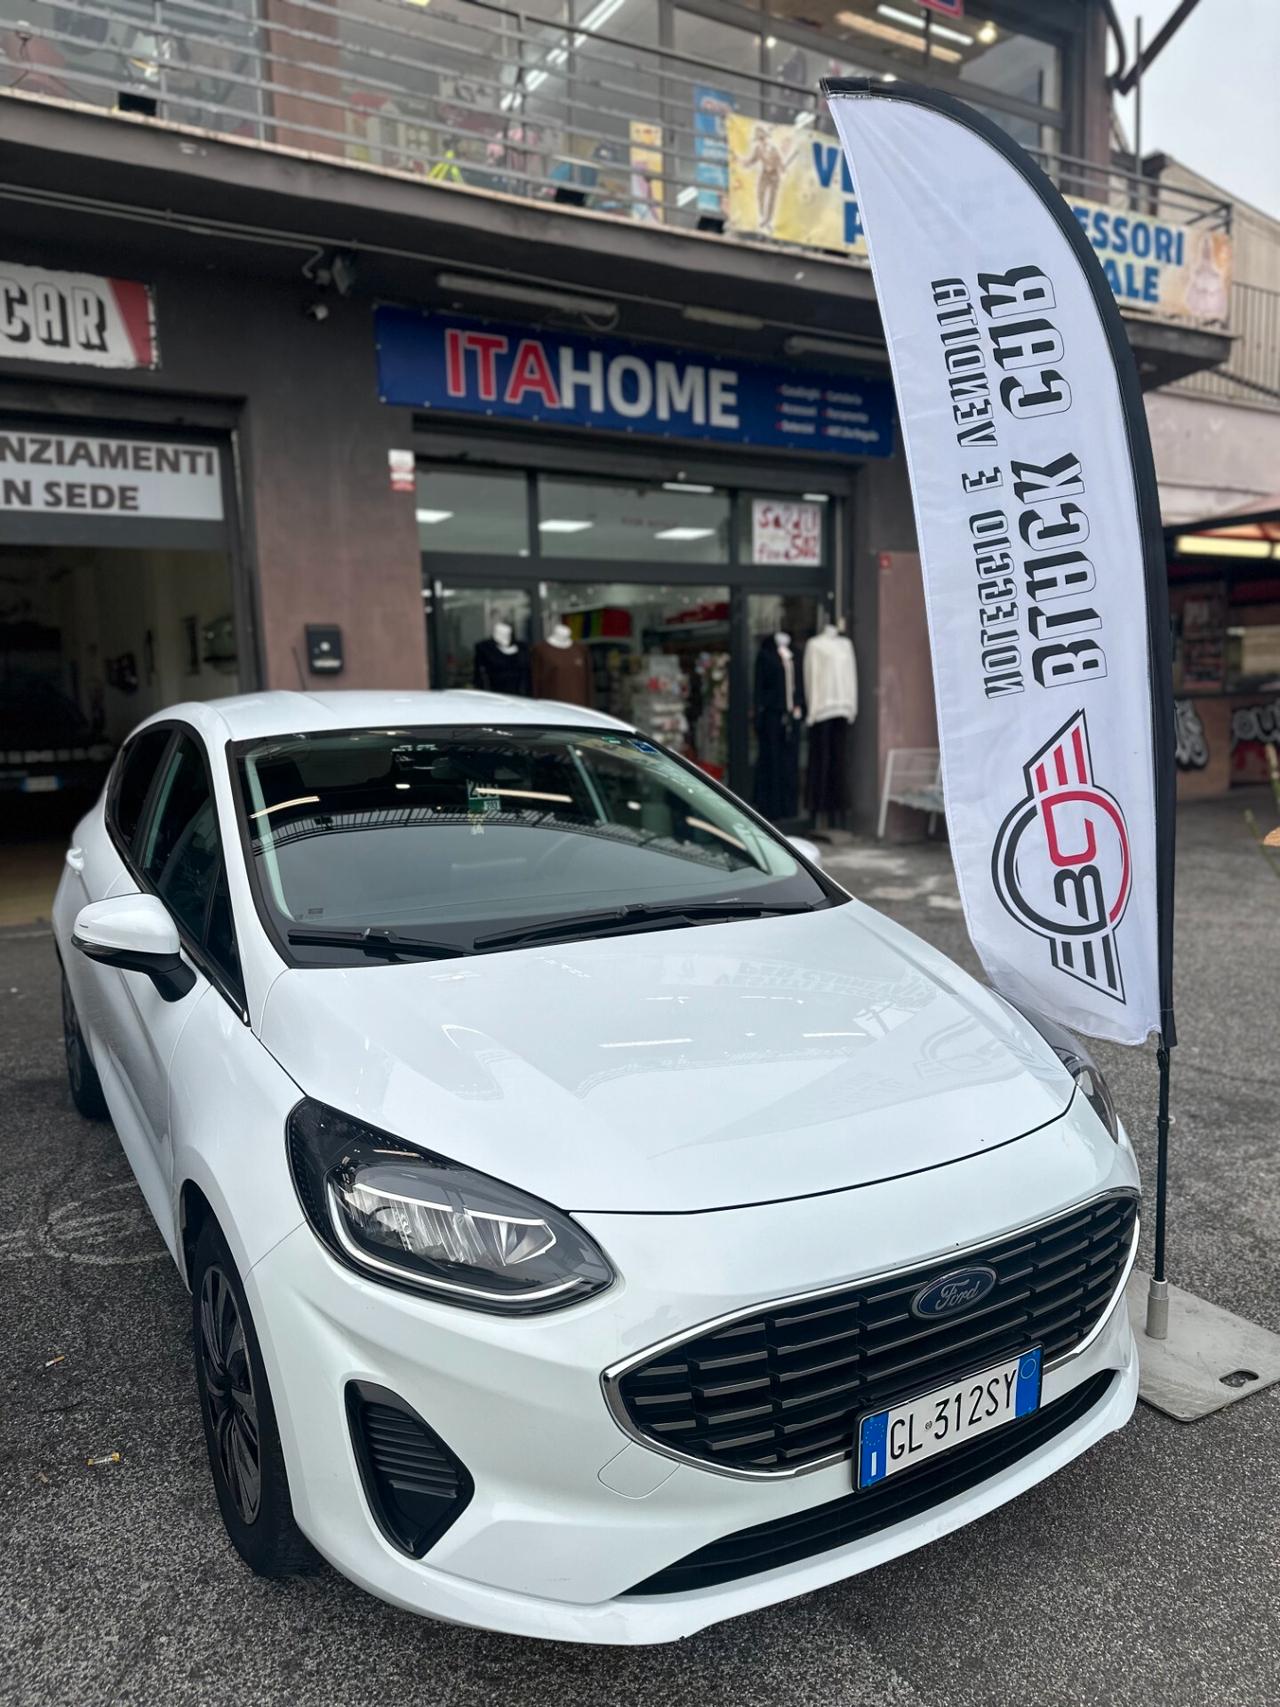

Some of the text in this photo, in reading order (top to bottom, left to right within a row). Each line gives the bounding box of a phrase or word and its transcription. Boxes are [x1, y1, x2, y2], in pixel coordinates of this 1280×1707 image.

[445, 328, 740, 430] ITAHOME
[0, 435, 215, 477] NZIAMENTI
[44, 481, 140, 511] SEDE
[934, 1278, 980, 1311] Ford
